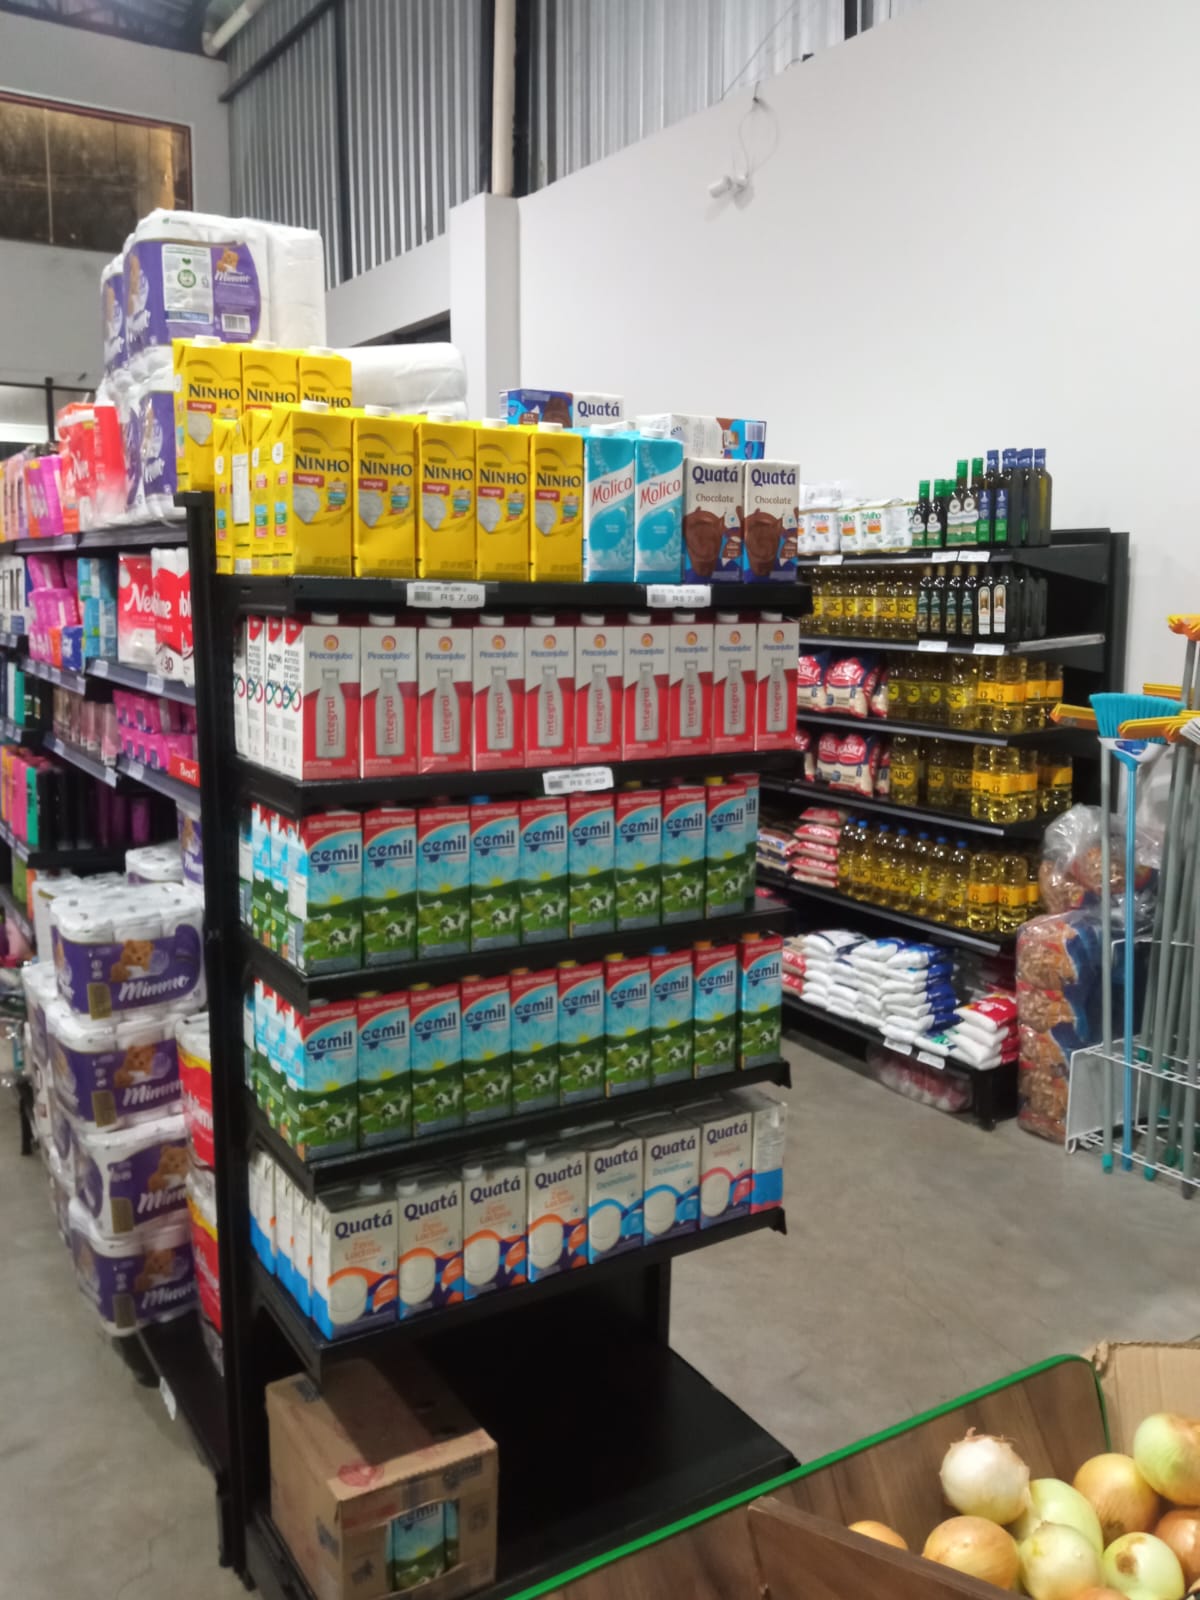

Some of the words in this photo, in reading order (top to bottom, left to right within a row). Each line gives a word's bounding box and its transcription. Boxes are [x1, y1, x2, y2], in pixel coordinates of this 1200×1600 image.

[188, 383, 240, 400] NINHO
[247, 388, 296, 403] NINHO
[577, 401, 620, 418] Quatá
[295, 454, 350, 473] NINHO
[360, 460, 412, 476] NINHO
[424, 464, 473, 481] NINHO
[479, 468, 527, 485] NINHO
[537, 472, 581, 488] NINHO
[692, 465, 738, 485] Quatá
[751, 468, 796, 487] Quatá
[592, 477, 632, 506] Molico
[640, 479, 681, 508] Molico
[695, 493, 735, 504] Chocolate
[754, 495, 792, 505] Chocolate
[620, 818, 659, 835] cemil
[666, 813, 702, 831] cemil
[710, 808, 743, 827] cemil
[473, 830, 515, 847] cemil
[523, 826, 565, 844] cemil
[572, 821, 610, 839] cemil
[310, 844, 359, 862] cemil
[367, 839, 413, 858] cemil
[422, 835, 467, 853] cemil
[699, 971, 734, 987] cemil
[747, 963, 779, 979] cemil
[610, 984, 647, 1002] cemil
[654, 976, 689, 993] cemil
[514, 996, 554, 1015] cemil
[562, 988, 601, 1007] cemil
[414, 1012, 456, 1033] cemil
[465, 1004, 506, 1024] cemil
[361, 1021, 405, 1041] cemil
[306, 1031, 353, 1052] cemil
[706, 1120, 748, 1145] Quatá
[651, 1135, 696, 1161] Quatá
[594, 1146, 639, 1174] Quatá
[534, 1160, 582, 1189] Quatá
[470, 1175, 520, 1205] Quatá
[404, 1190, 458, 1221] Quatá
[335, 1209, 393, 1240] Quatá
